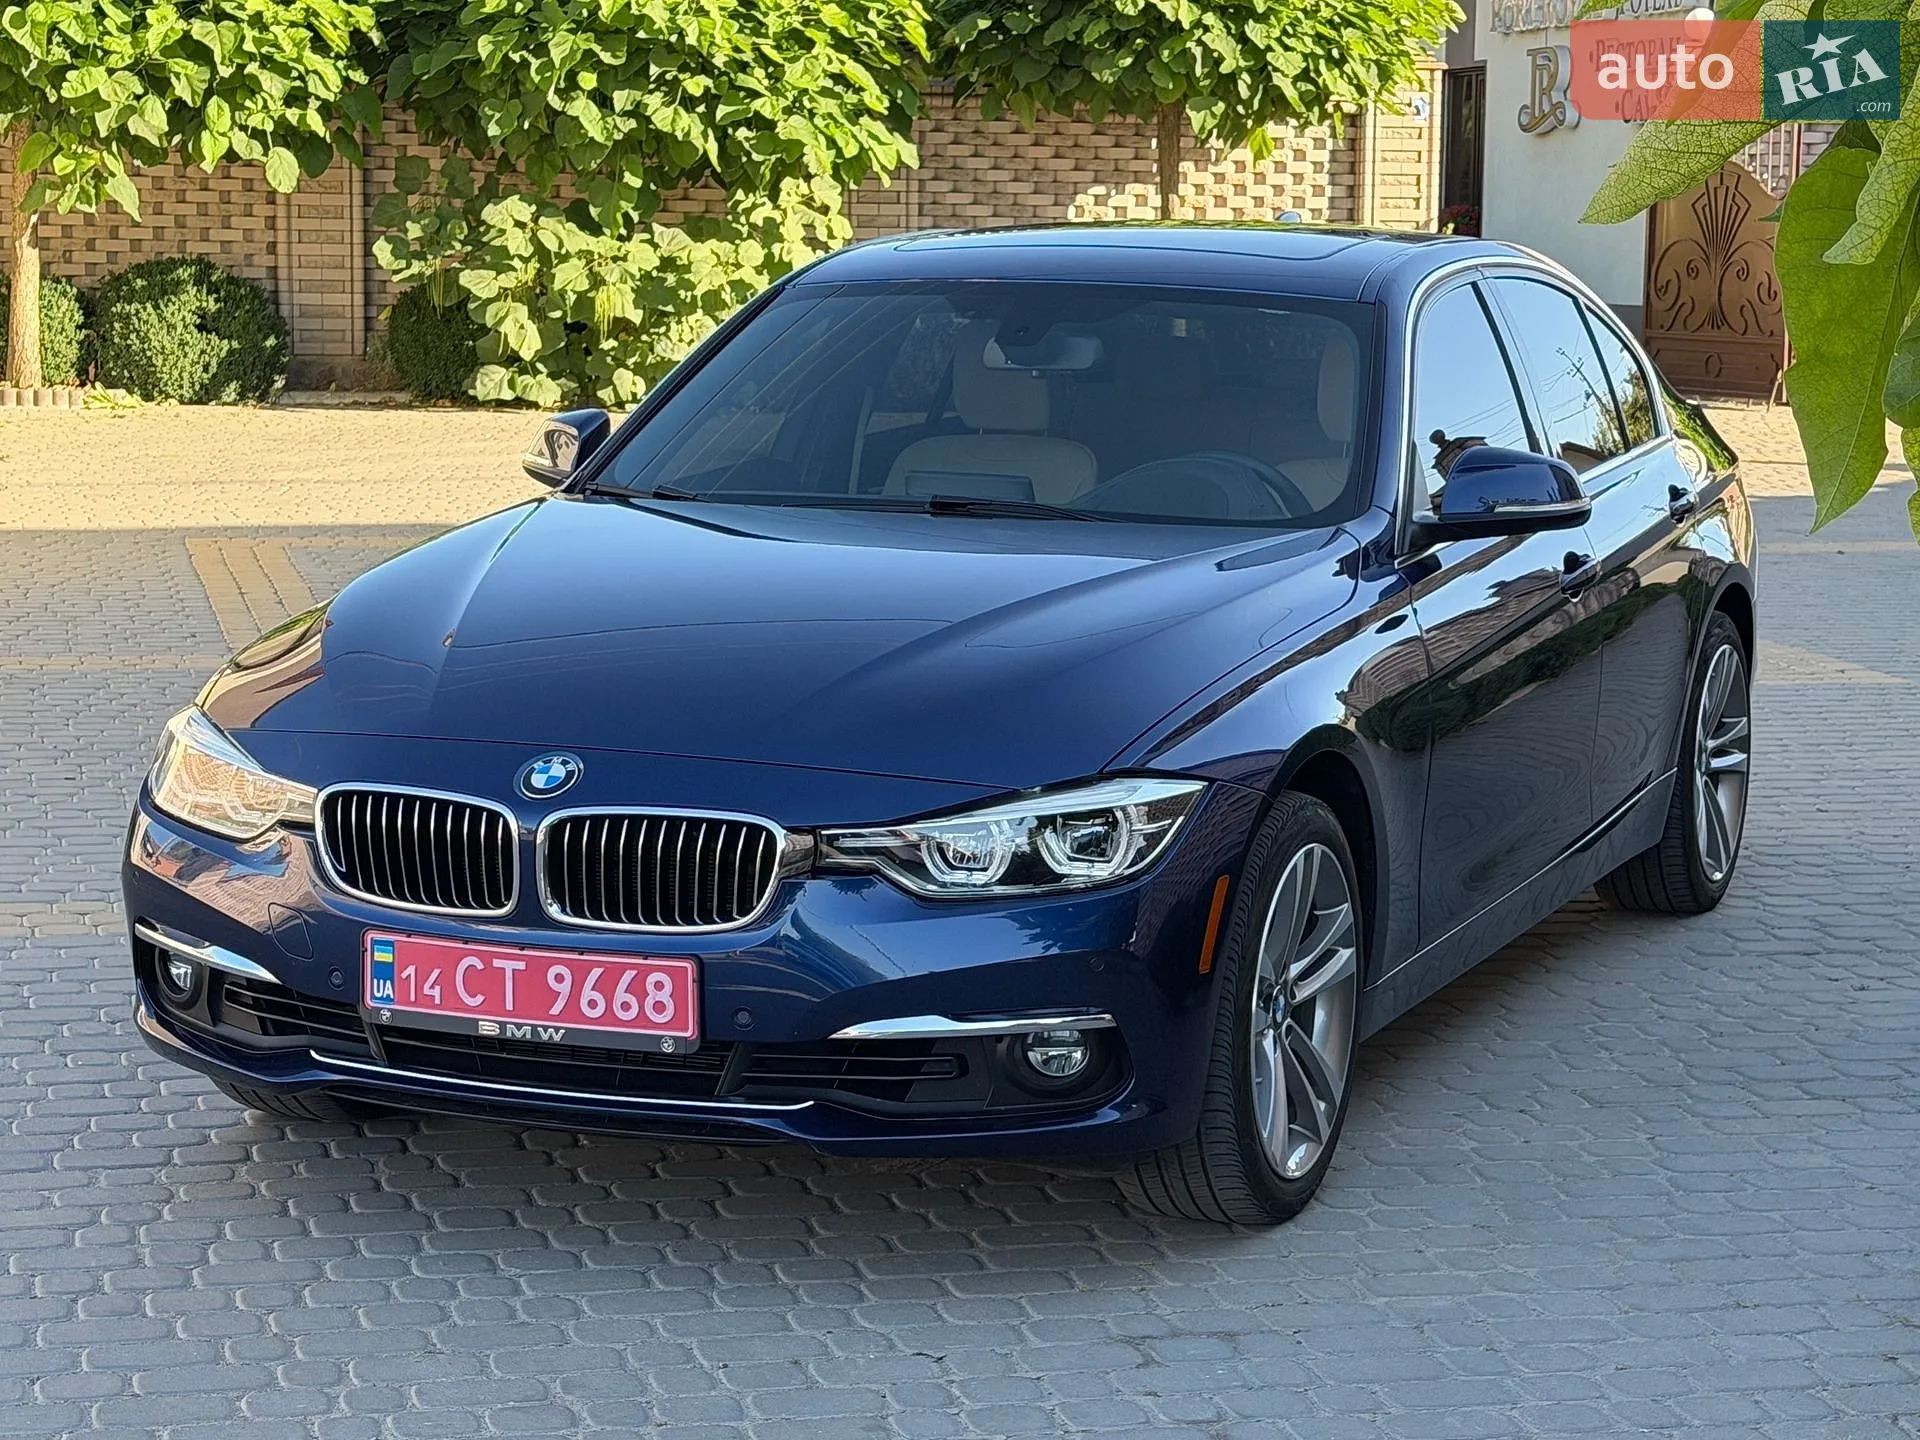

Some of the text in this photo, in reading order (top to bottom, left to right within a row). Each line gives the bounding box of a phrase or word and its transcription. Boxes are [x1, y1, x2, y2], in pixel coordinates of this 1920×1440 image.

[373, 979, 394, 999] UA
[400, 956, 675, 1024] 14 CT 9668
[478, 1021, 565, 1042] BMW
